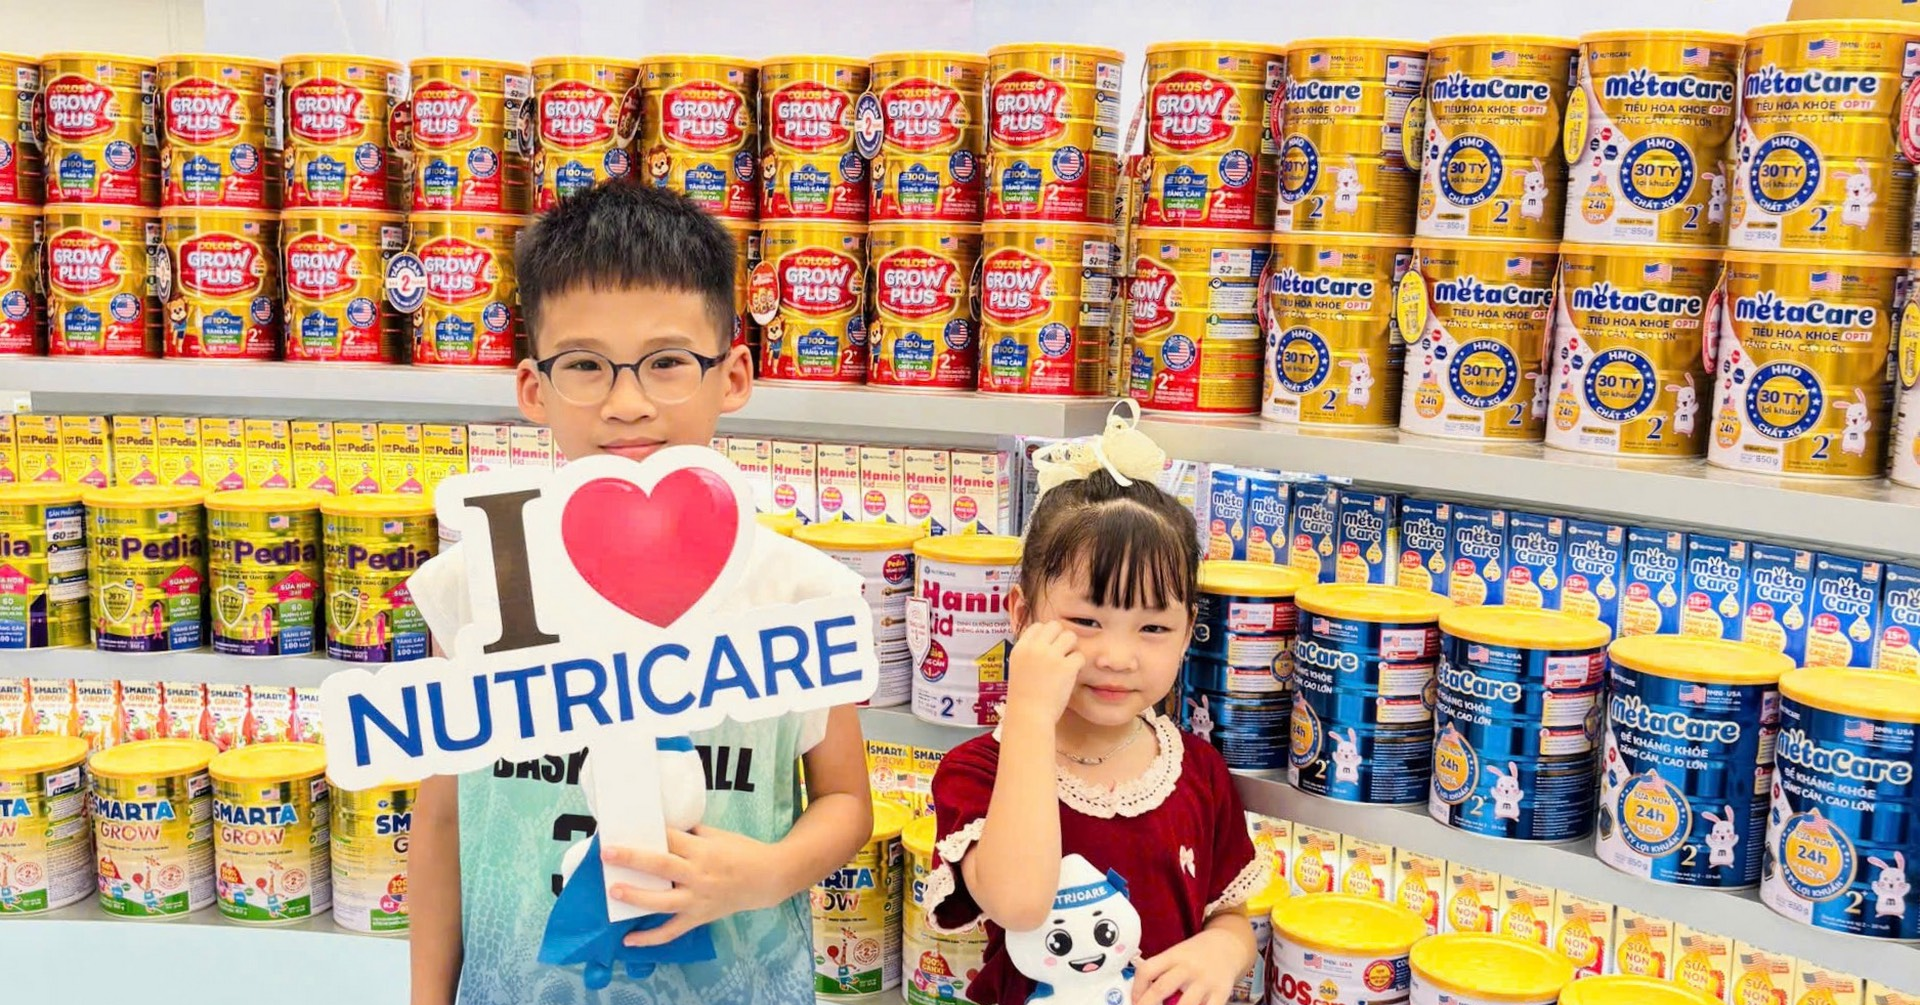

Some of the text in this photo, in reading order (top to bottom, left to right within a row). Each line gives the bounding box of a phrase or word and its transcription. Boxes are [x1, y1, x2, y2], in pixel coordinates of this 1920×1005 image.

[1003, 82, 1036, 91] COLOS
[1166, 82, 1203, 92] COLOS
[49, 94, 103, 111] GROW
[171, 96, 231, 113] GROW
[295, 95, 355, 112] GROW
[416, 97, 467, 115] GROW
[545, 98, 604, 118] GROW
[887, 98, 950, 119] GROW
[996, 90, 1055, 113] GROW
[1156, 90, 1224, 115] GROW
[670, 99, 734, 119] GROW
[778, 98, 842, 120] GROW
[54, 112, 95, 126] PLUS
[177, 115, 220, 130] PLUS
[302, 114, 345, 129] PLUS
[420, 118, 458, 133] PLUS
[1000, 114, 1044, 132] PLUS
[1162, 117, 1212, 134] PLUS
[552, 120, 595, 135] PLUS
[679, 121, 727, 137] PLUS
[785, 121, 831, 137] PLUS
[893, 121, 941, 136] PLUS
[1459, 138, 1484, 147] HMO
[1647, 139, 1674, 149] HMO
[1772, 137, 1799, 148] HMO
[1635, 164, 1655, 176] 30
[1761, 163, 1780, 178] 30
[1588, 200, 1606, 210] 24h
[53, 244, 109, 264] GROW
[187, 249, 250, 268] GROW
[796, 257, 832, 266] COLOS
[893, 258, 928, 267] COLOS
[59, 266, 100, 281] PLUS
[195, 268, 243, 284] PLUS
[785, 262, 850, 283] GROW
[884, 264, 948, 287] GROW
[1218, 266, 1232, 274] 52
[297, 270, 337, 285] PLUS
[402, 275, 411, 291] 2
[430, 275, 473, 290] PLUS
[792, 285, 841, 302] PLUS
[890, 288, 936, 304] PLUS
[989, 291, 1031, 308] PLUS
[1291, 331, 1312, 340] HMO
[1845, 332, 1868, 341] OPTI
[1473, 342, 1499, 351] HMO
[1609, 351, 1637, 362] HMO
[1771, 364, 1801, 377] HMO
[1598, 375, 1617, 387] 30
[1420, 396, 1437, 405] 24h
[1760, 390, 1780, 403] 30
[1720, 422, 1734, 433] 24h
[31, 436, 58, 445] Pedia
[76, 436, 103, 445] Pedia
[127, 436, 153, 445] Pedia
[170, 438, 196, 447] Pedia
[258, 440, 286, 450] Pedia
[305, 442, 331, 452] Pedia
[471, 446, 507, 457] Hanie
[513, 447, 549, 459] Hanie
[774, 463, 812, 476] Hanie
[820, 466, 857, 479] Hanie
[863, 469, 900, 482] Hanie
[907, 472, 946, 485] Hanie
[953, 474, 994, 488] Hanie
[52, 532, 65, 540] 60
[121, 535, 201, 560] Pedia
[234, 540, 316, 564] Pedia
[349, 545, 432, 570] Pedia
[463, 489, 560, 653] I
[1506, 652, 1522, 660] USA
[124, 686, 156, 694] SMARTA
[1439, 664, 1521, 703] etaCare
[348, 615, 862, 767] NUTRICARE
[1897, 727, 1914, 737] USA
[870, 744, 908, 757] SMARTA
[1441, 756, 1459, 772] 24h
[91, 796, 175, 821] SMARTA
[214, 800, 298, 826] SMARTA
[1636, 805, 1665, 822] 24h
[100, 821, 161, 841] GROW
[221, 827, 285, 846] GROW
[1637, 824, 1663, 837] USA
[1798, 845, 1828, 866] 24h
[1301, 867, 1321, 877] NON
[1798, 863, 1827, 881] USA
[1350, 881, 1371, 891] NON
[1404, 893, 1426, 903] NON
[1456, 907, 1479, 919] NON
[1509, 922, 1533, 934] NON
[1565, 938, 1588, 950] NON
[1626, 954, 1650, 965] NON
[1683, 971, 1709, 983] NON
[1319, 986, 1338, 996] 24h
[1743, 990, 1770, 1003] NON
